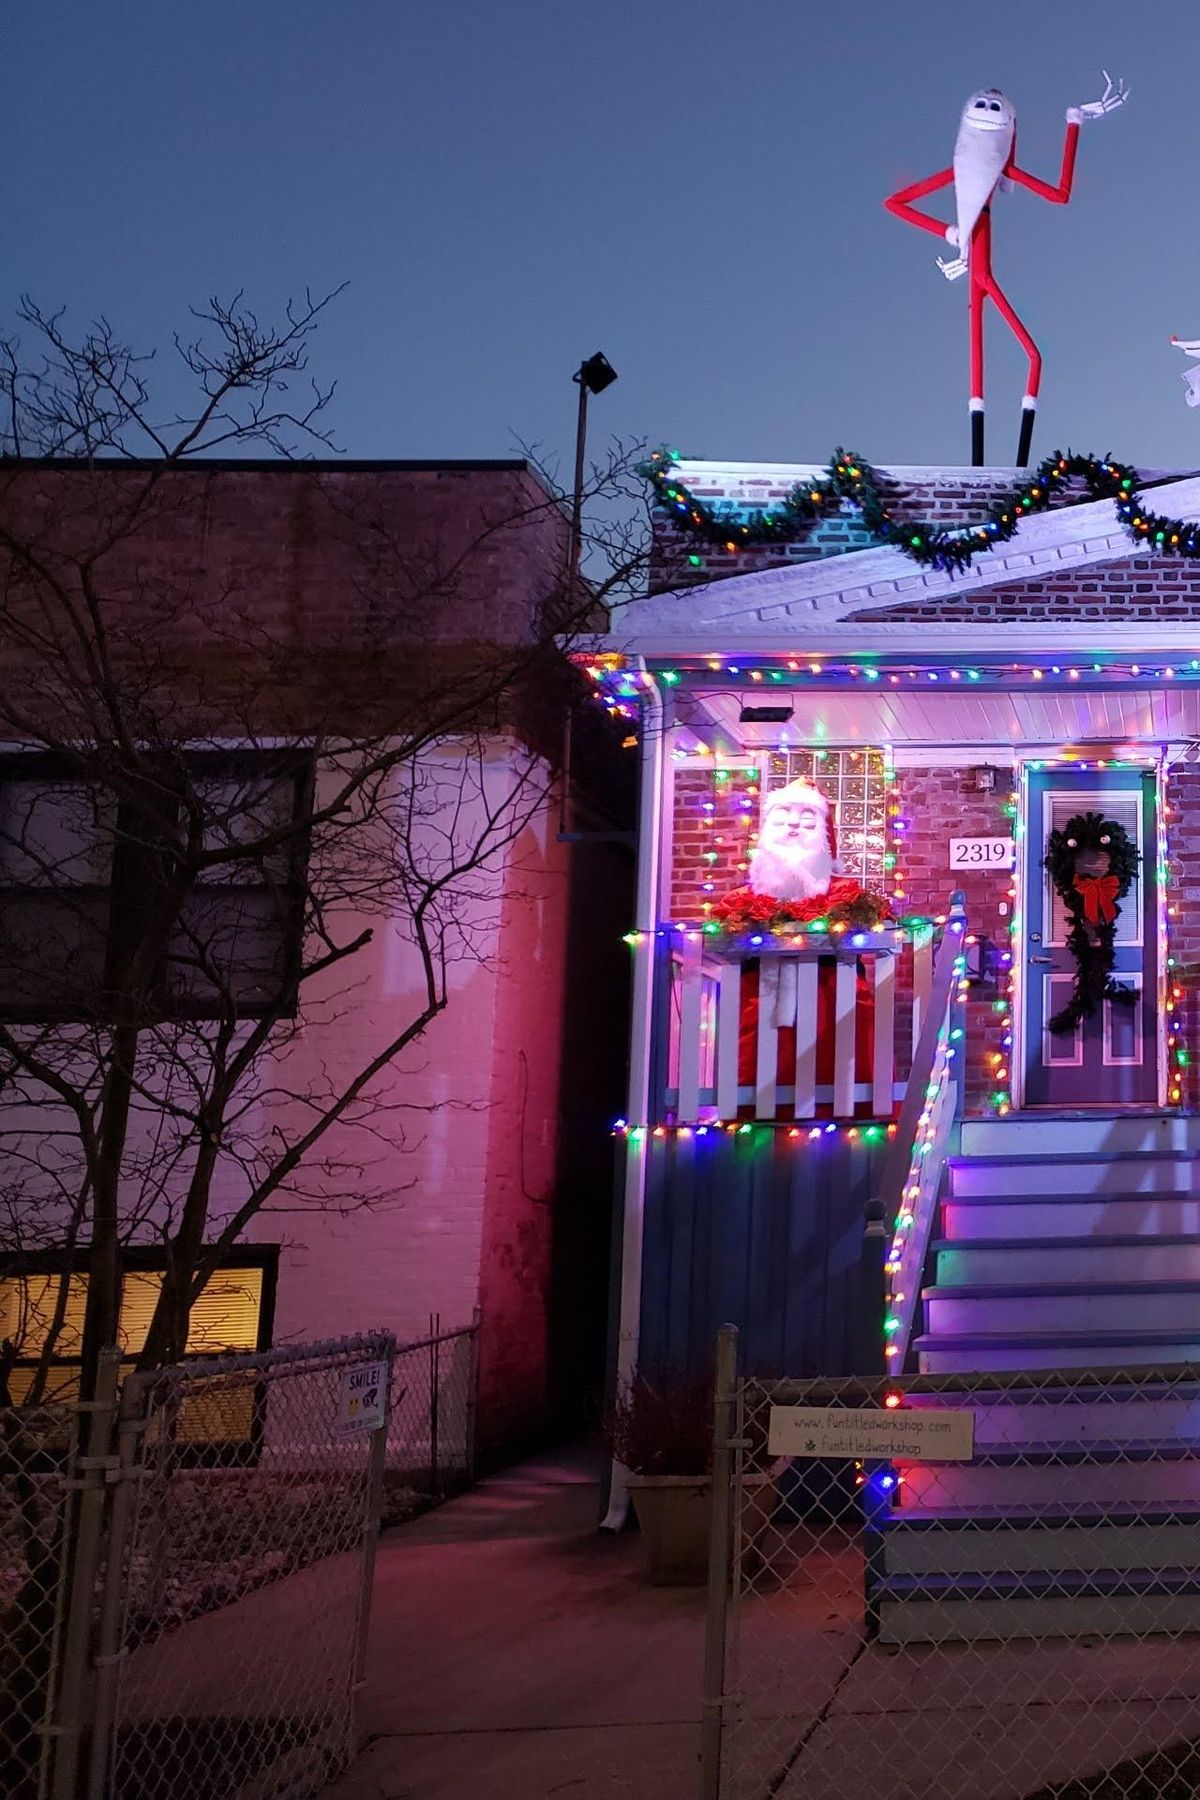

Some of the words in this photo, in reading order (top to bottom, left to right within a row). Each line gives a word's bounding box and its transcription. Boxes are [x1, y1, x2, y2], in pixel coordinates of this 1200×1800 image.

[956, 843, 1005, 862] 2319
[349, 1370, 380, 1390] SMILE!
[821, 1434, 921, 1456] funtitledworkshop
